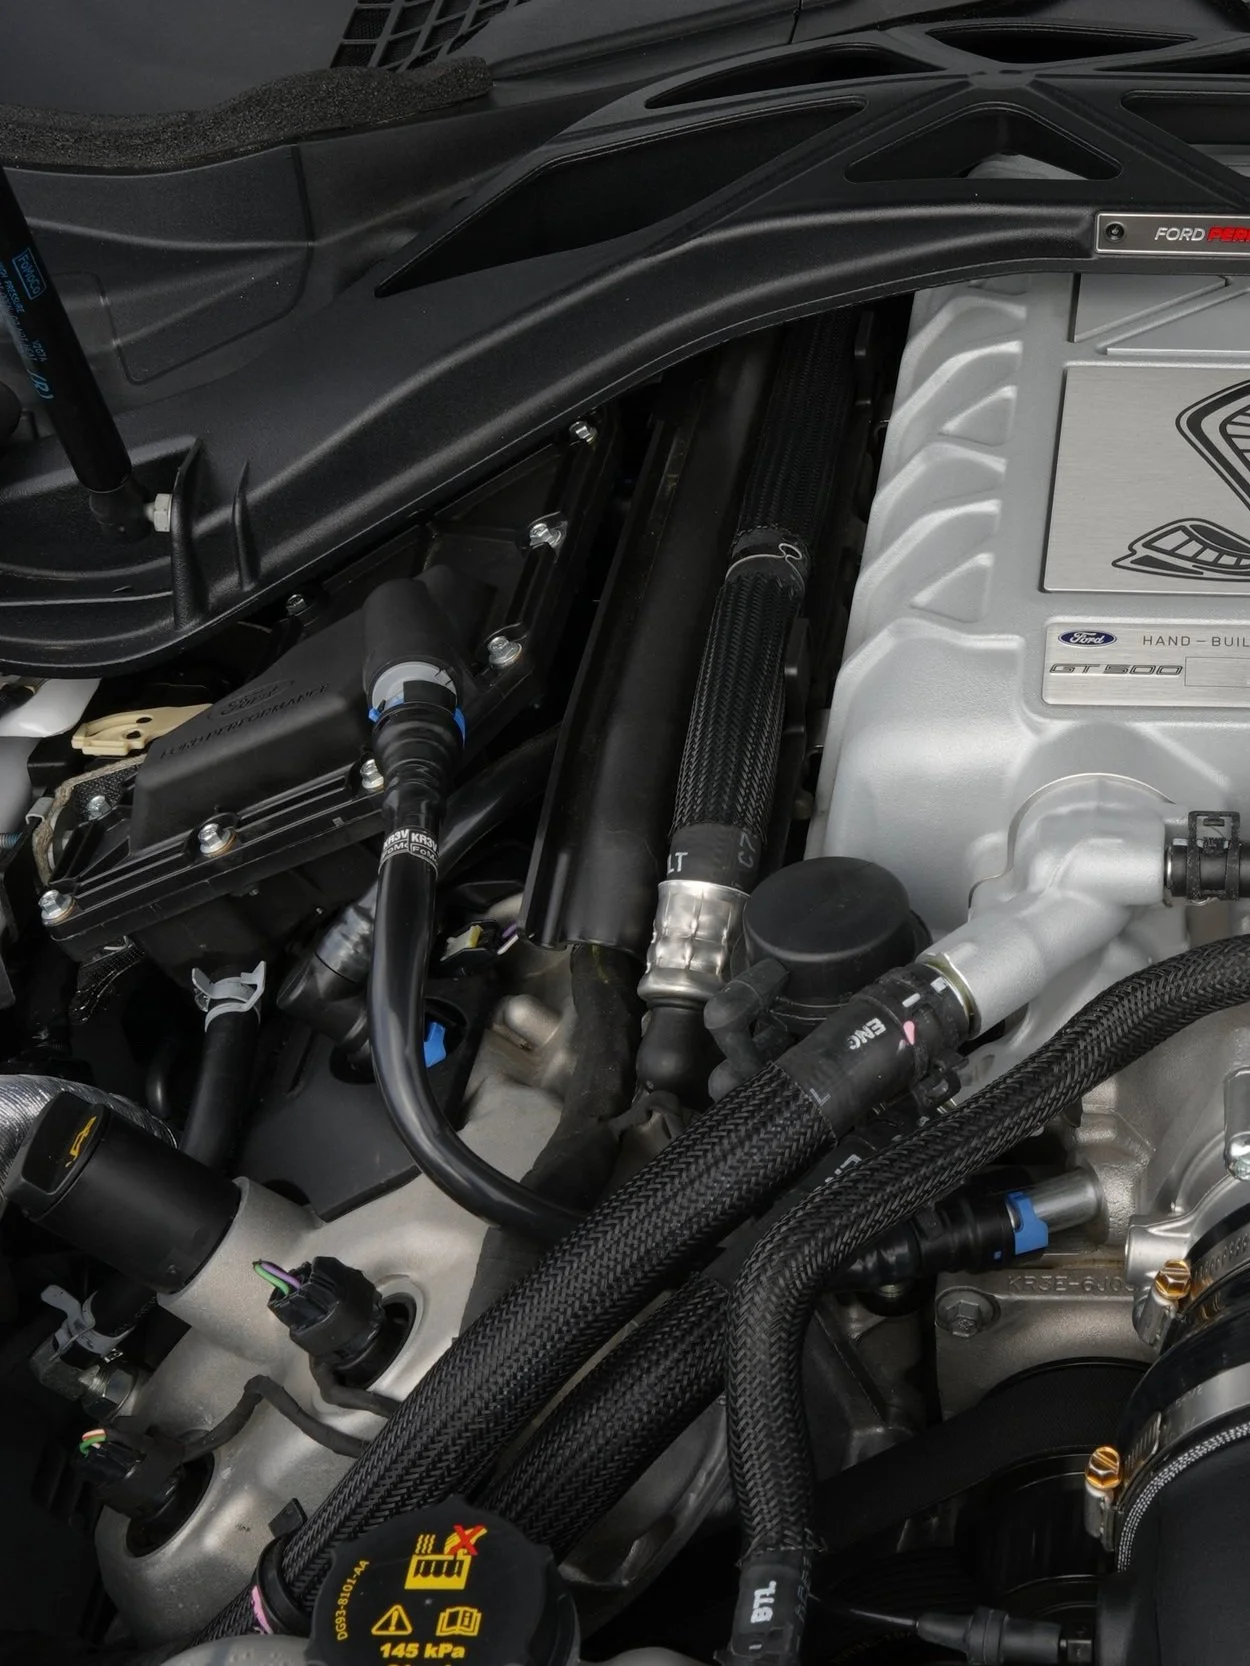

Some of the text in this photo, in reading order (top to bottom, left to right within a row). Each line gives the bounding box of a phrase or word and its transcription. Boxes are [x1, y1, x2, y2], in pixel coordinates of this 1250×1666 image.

[1154, 227, 1205, 241] FORD
[1070, 631, 1106, 644] Ford
[205, 682, 329, 739] PERFORMANCE
[411, 832, 438, 853] KR3V
[847, 1017, 887, 1050] ENG
[334, 1558, 370, 1641] DG93-8101-AA
[750, 1580, 777, 1624] BTL
[379, 1642, 466, 1659] 145 kPa
